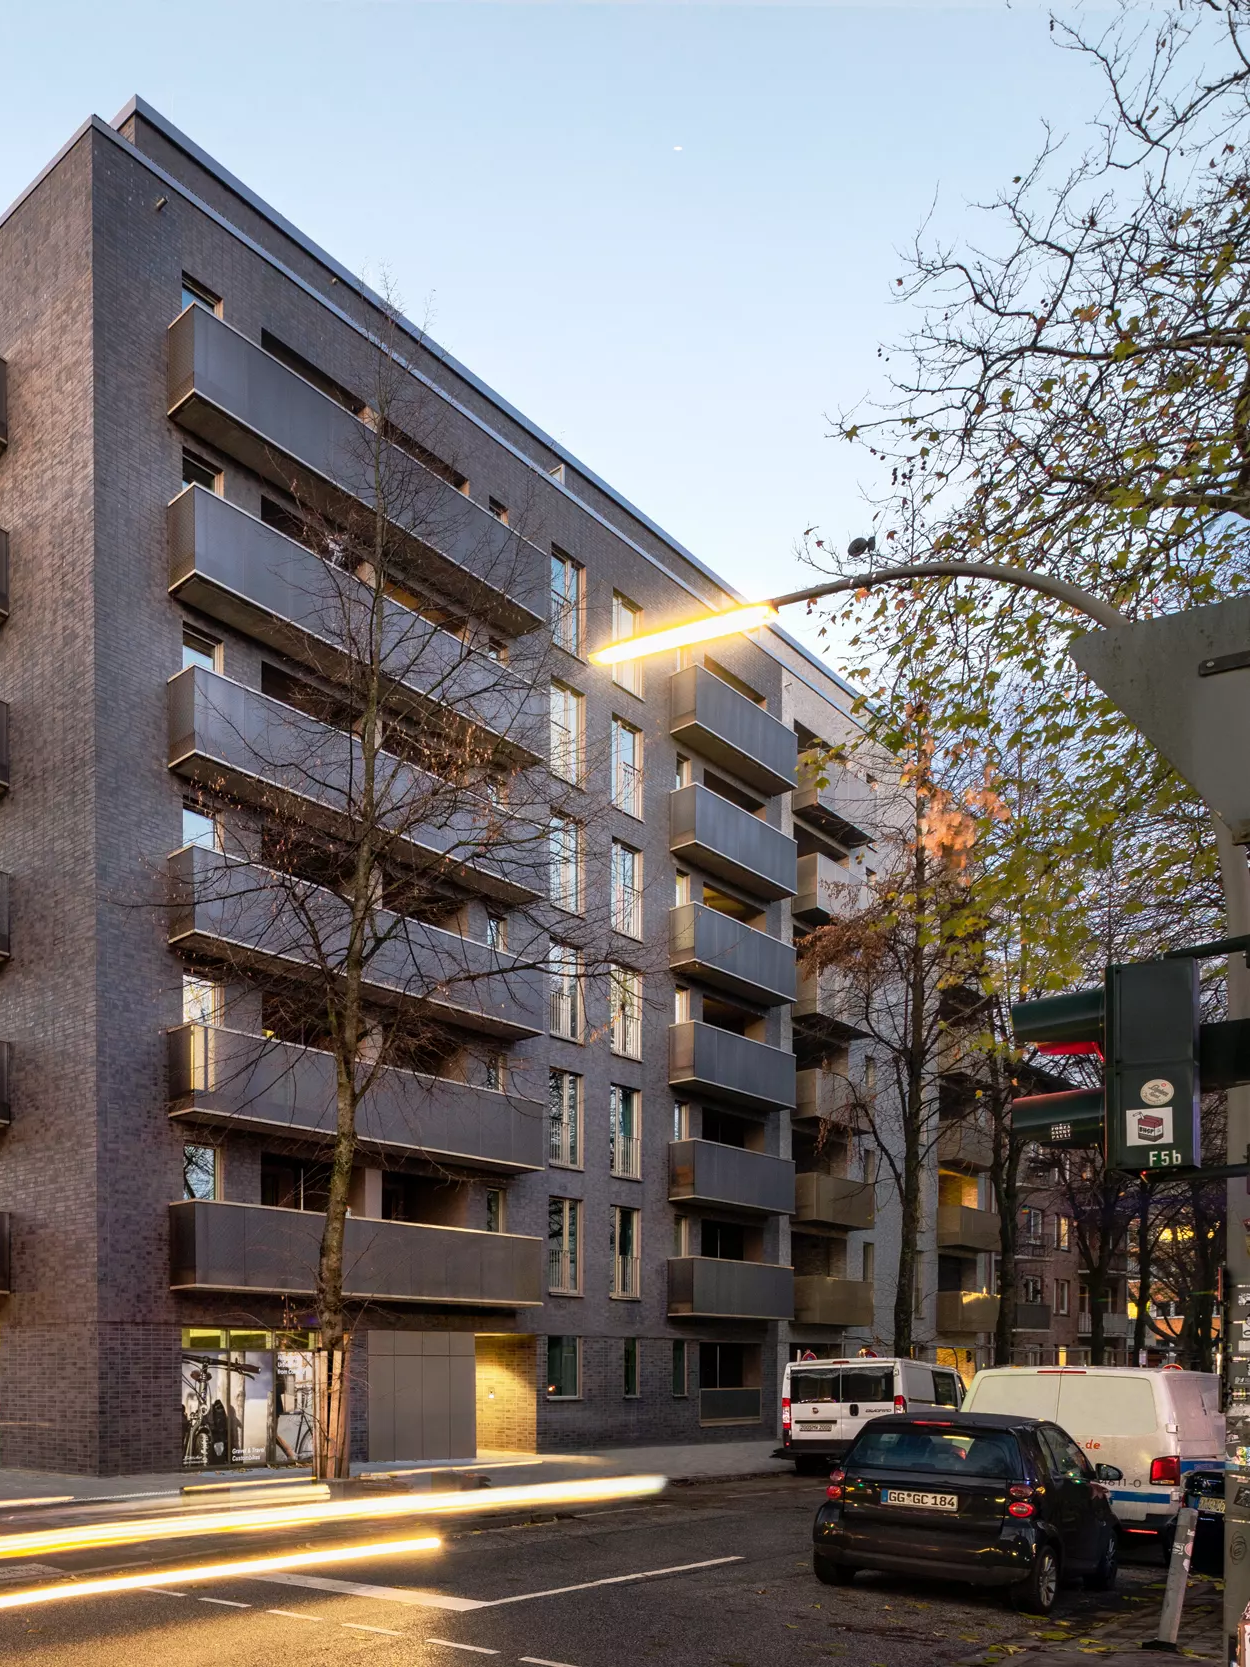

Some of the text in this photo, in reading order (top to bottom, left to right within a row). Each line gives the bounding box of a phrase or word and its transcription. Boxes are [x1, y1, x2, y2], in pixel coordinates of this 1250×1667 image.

[889, 1492, 955, 1507] GG GC 184
